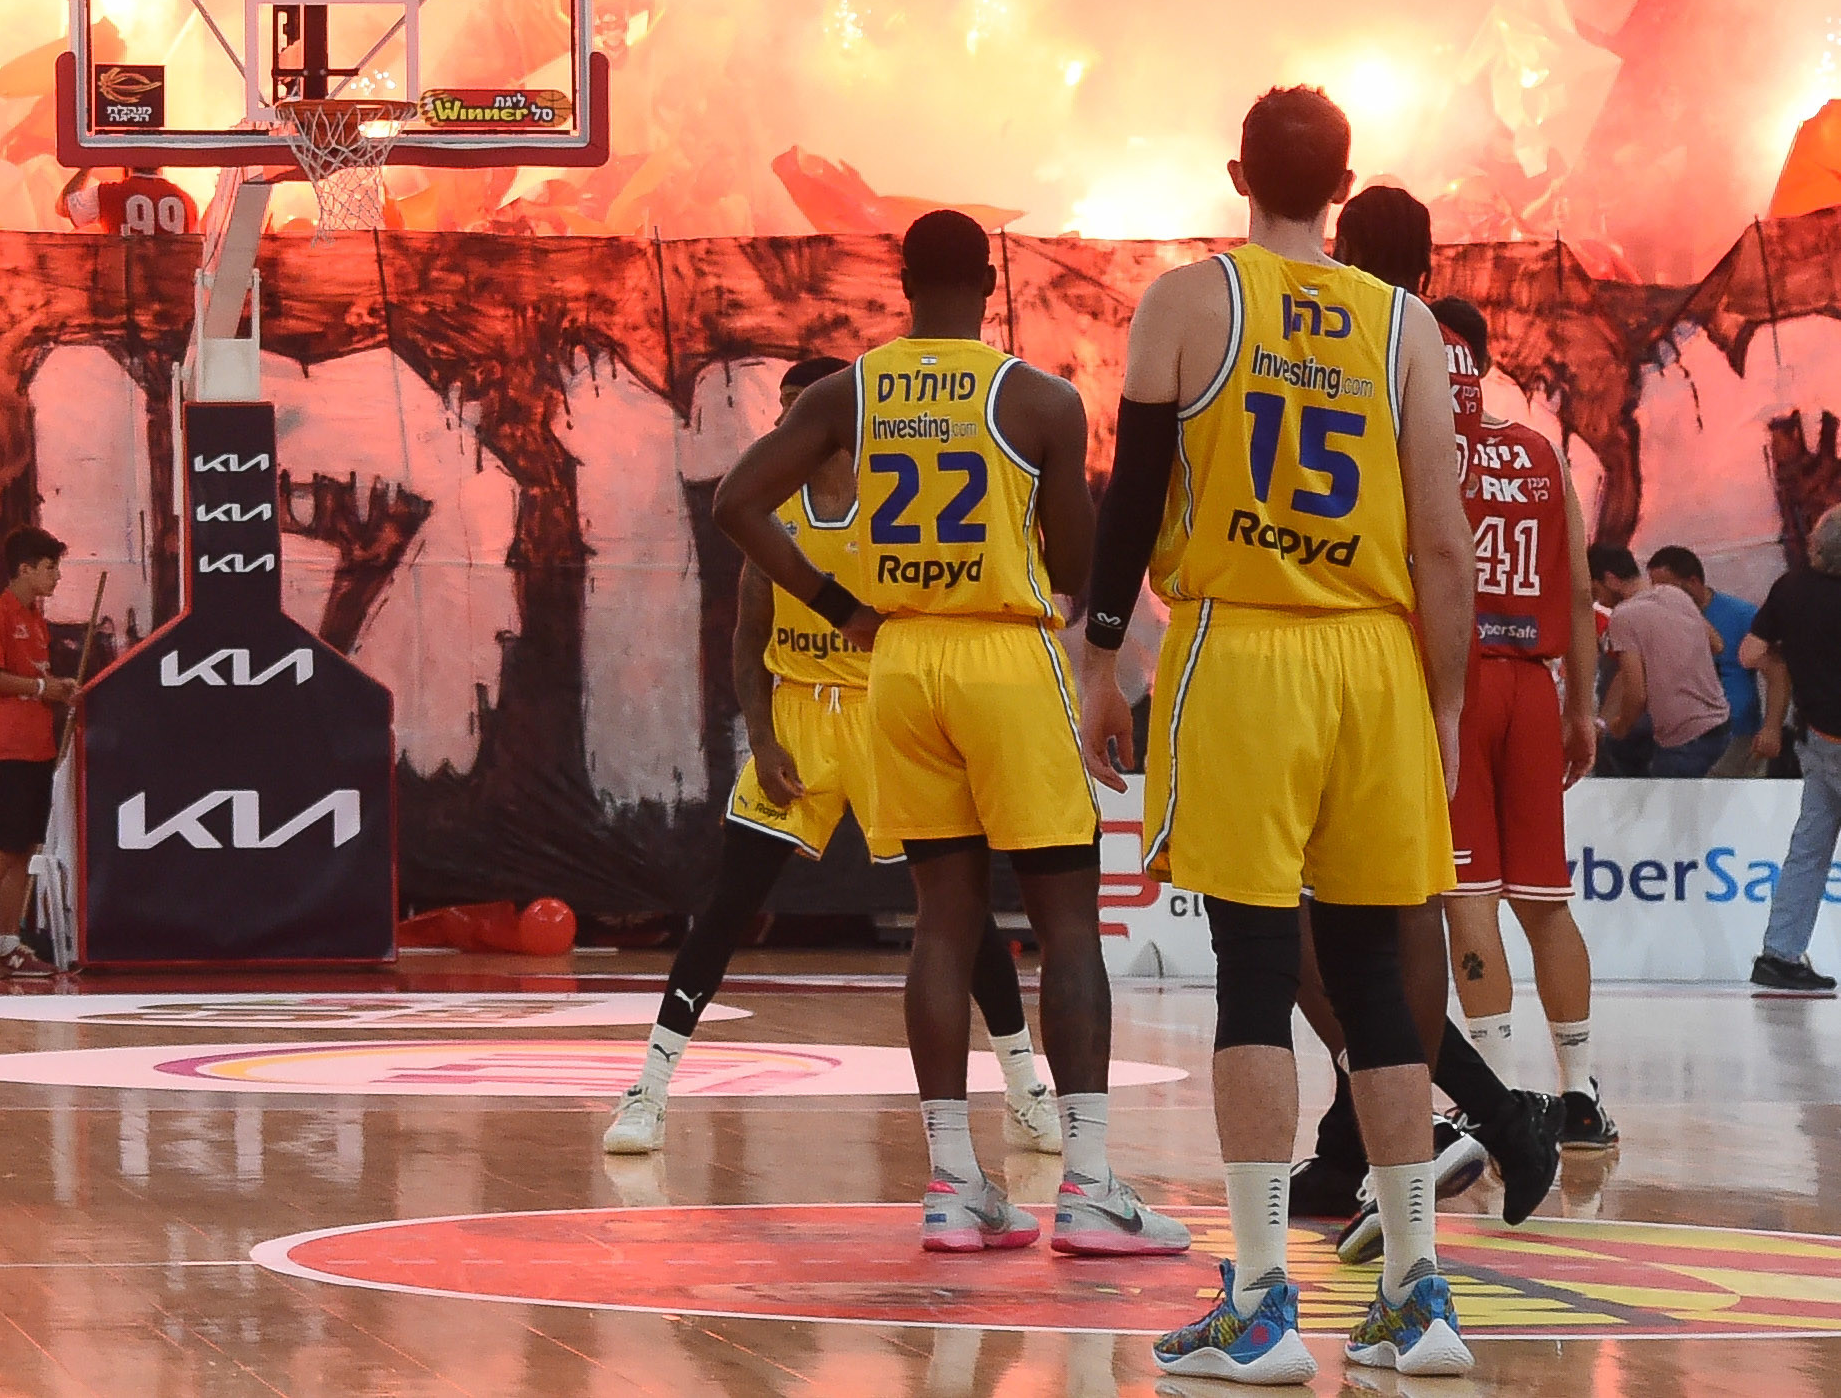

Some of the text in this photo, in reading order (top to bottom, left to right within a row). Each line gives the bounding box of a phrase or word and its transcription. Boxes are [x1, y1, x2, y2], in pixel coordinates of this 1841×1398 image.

[432, 98, 554, 122] Winner סל
[493, 92, 526, 109] ליגת
[1281, 293, 1352, 341] כהן
[1244, 391, 1367, 519] 15
[868, 451, 988, 545] 22
[1481, 474, 1529, 503] RK
[1226, 508, 1362, 568] Rapyd
[1473, 515, 1541, 596] 41
[876, 553, 985, 589] Rapyd
[1477, 622, 1538, 640] yberSafe
